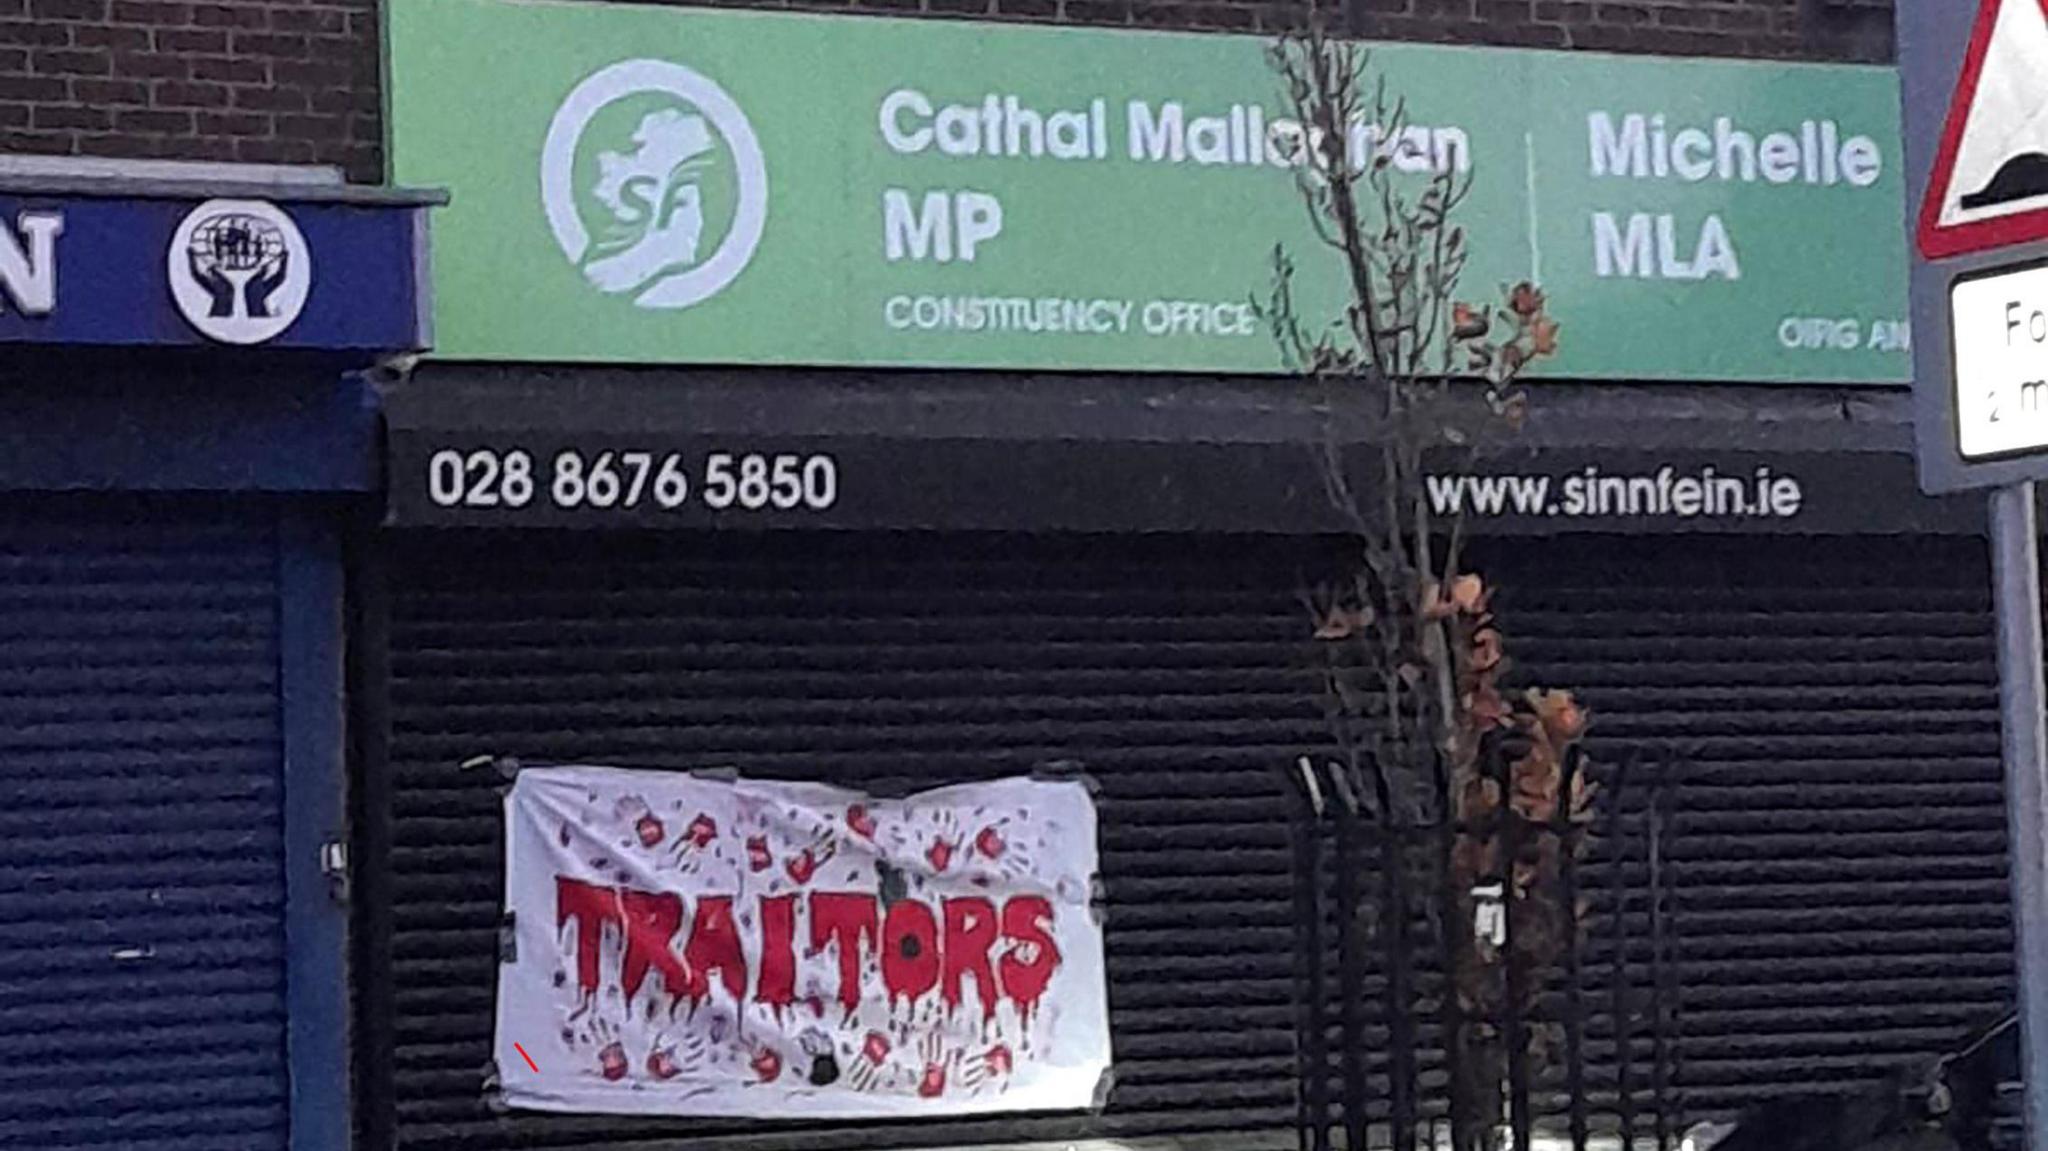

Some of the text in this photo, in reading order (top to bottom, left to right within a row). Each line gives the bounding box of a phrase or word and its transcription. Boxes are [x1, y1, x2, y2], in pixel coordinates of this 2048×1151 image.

[880, 90, 1106, 160] Cathal
[1587, 111, 1881, 187] Michelle
[884, 189, 1003, 263] MP
[1592, 212, 1741, 280] MLA
[885, 295, 1257, 337] CONSTITUENCY OFFICE
[429, 449, 837, 508] 028 8676 5850
[1426, 465, 1801, 516] www.sinnfein.ie
[555, 874, 1062, 1024] TRAITORS
